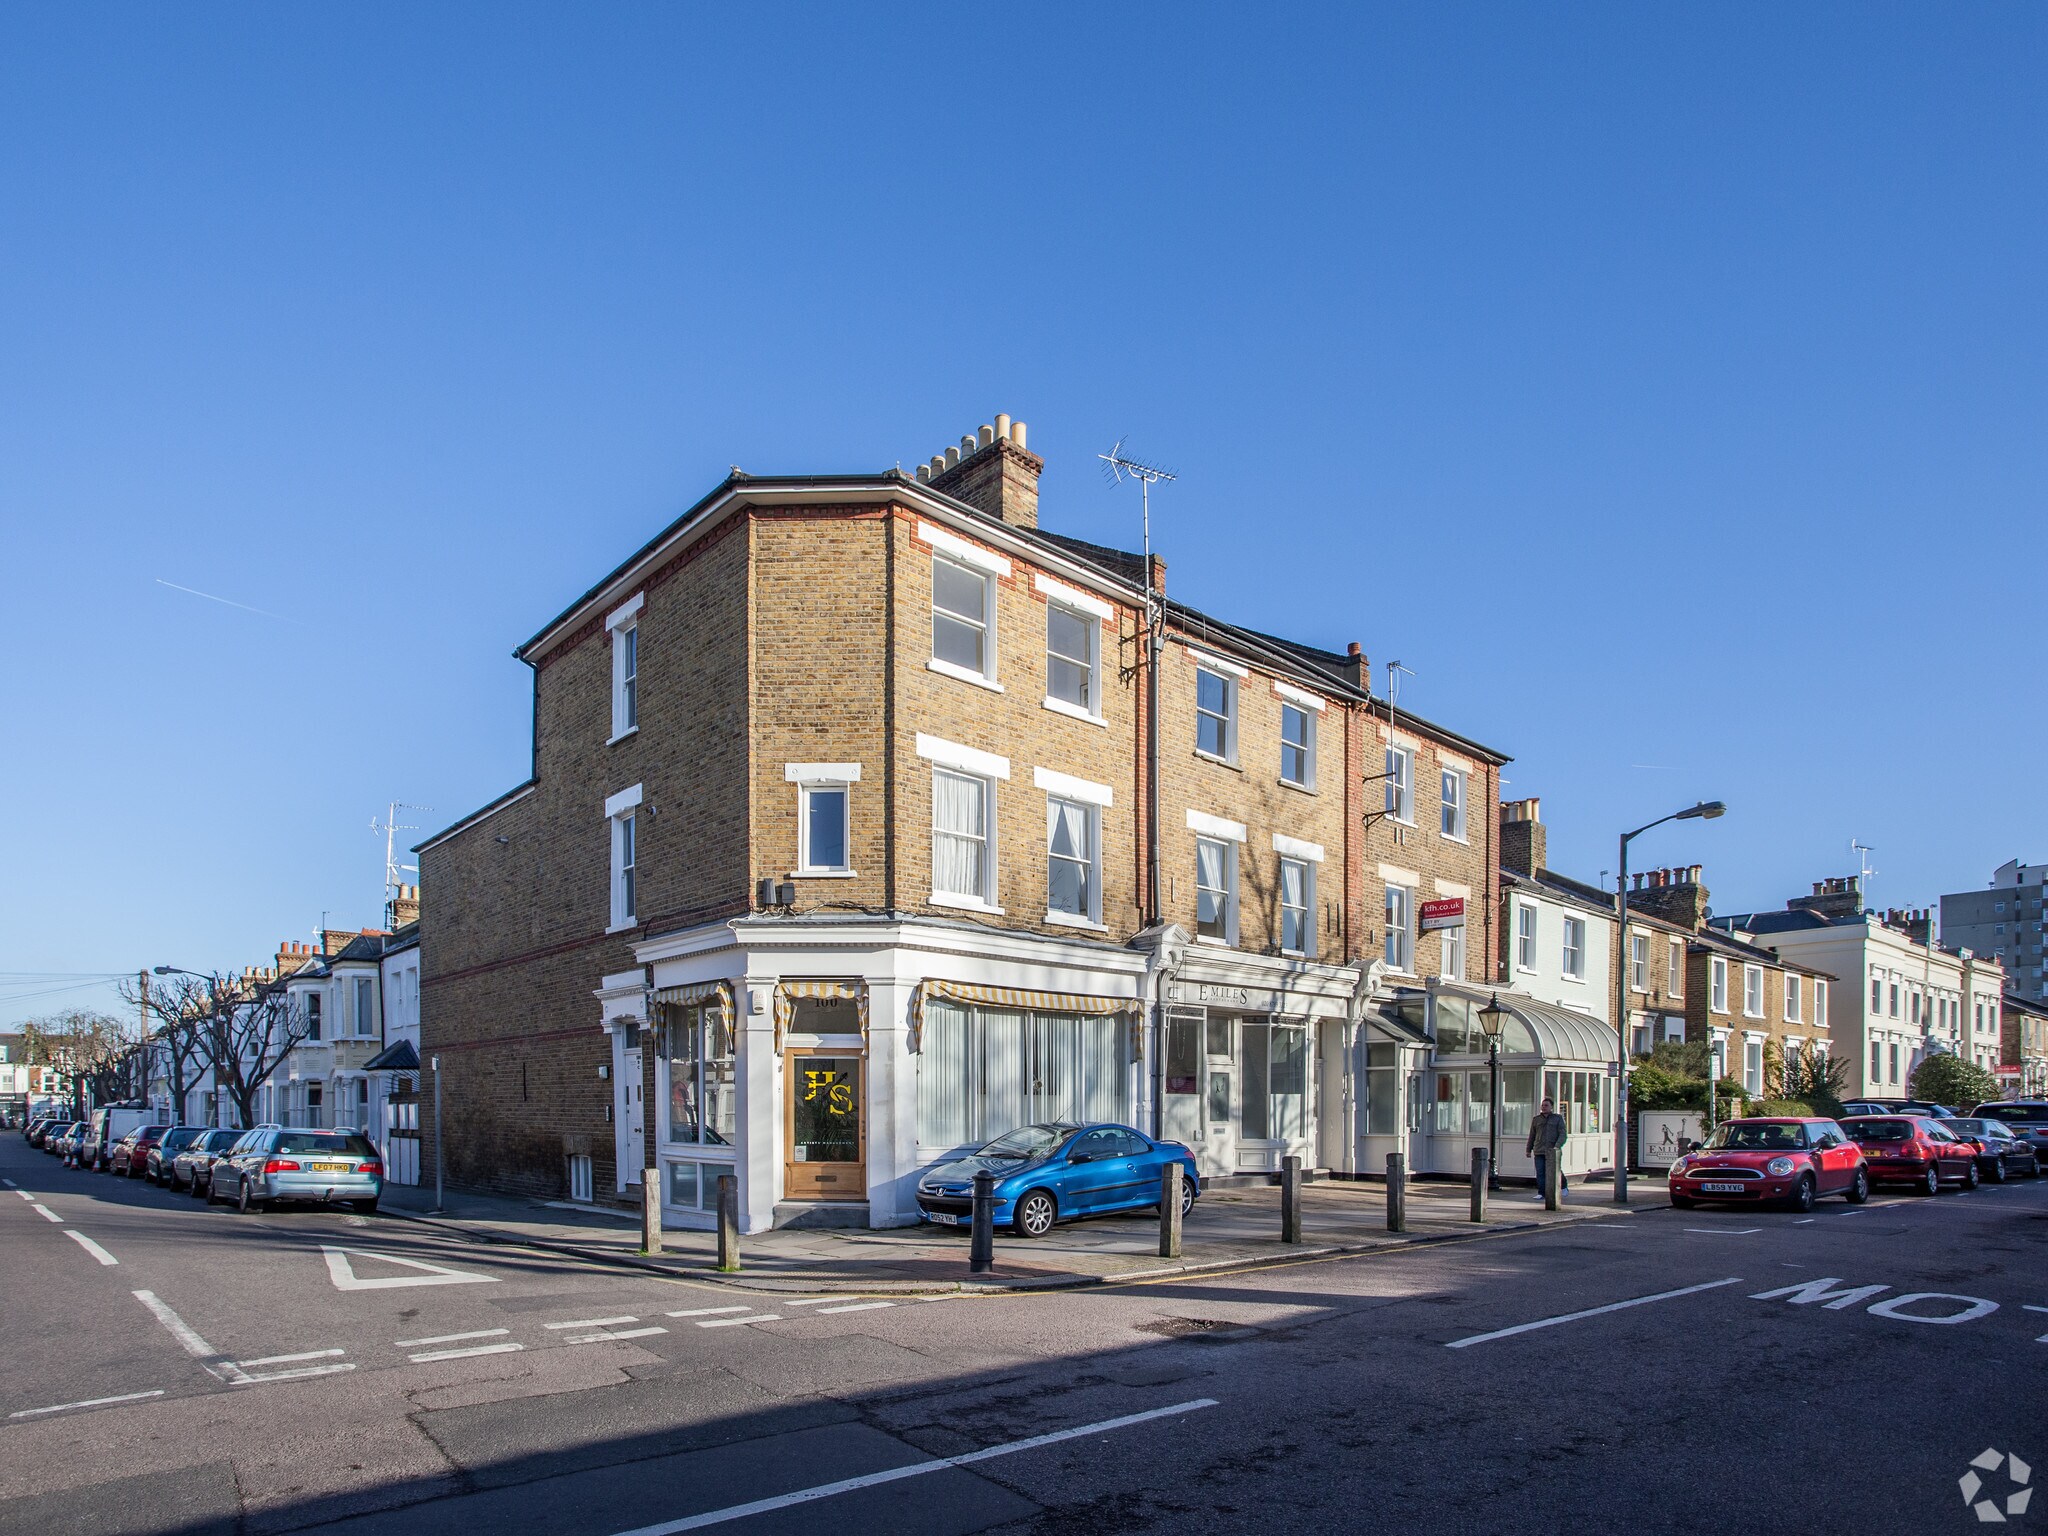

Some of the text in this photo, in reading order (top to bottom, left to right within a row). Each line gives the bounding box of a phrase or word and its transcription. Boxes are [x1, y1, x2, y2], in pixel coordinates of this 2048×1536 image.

[1424, 902, 1460, 912] kfh.co.uk
[1199, 985, 1248, 1004] EMILES
[815, 998, 837, 1007] 100
